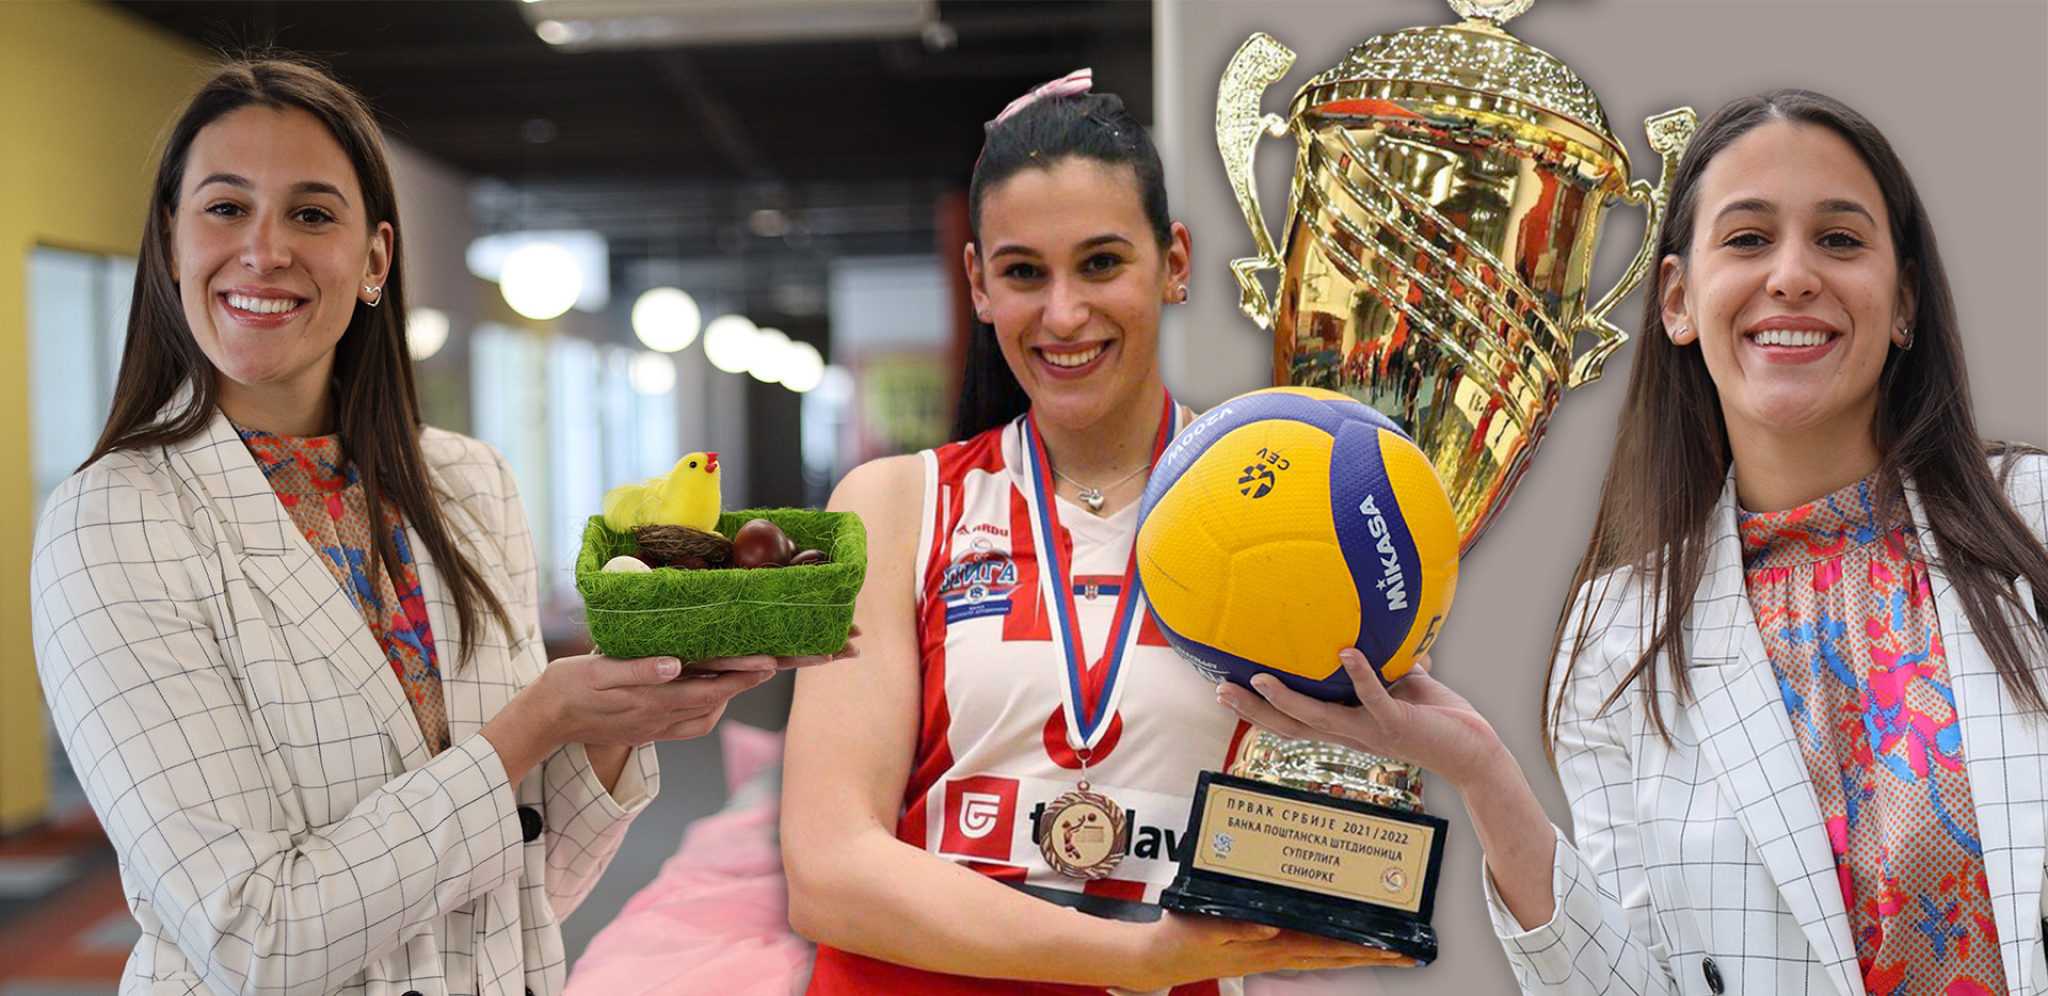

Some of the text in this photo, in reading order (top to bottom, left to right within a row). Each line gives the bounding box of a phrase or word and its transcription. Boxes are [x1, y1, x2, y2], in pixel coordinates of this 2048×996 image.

[1168, 407, 1234, 466] V200W
[1256, 447, 1290, 471] CEV
[1359, 494, 1408, 611] MIKASA
[1029, 802, 1187, 862] tlav
[1227, 798, 1274, 817] ПРВАК
[1282, 809, 1337, 830] СРБИЈЕ
[1228, 817, 1403, 861] БАНКА ПОШТАНСКА ШТЕДИОНИЦА
[1282, 846, 1340, 866] СУПЕРЛИГА
[1281, 863, 1336, 883] СЕНИОРКЕ
